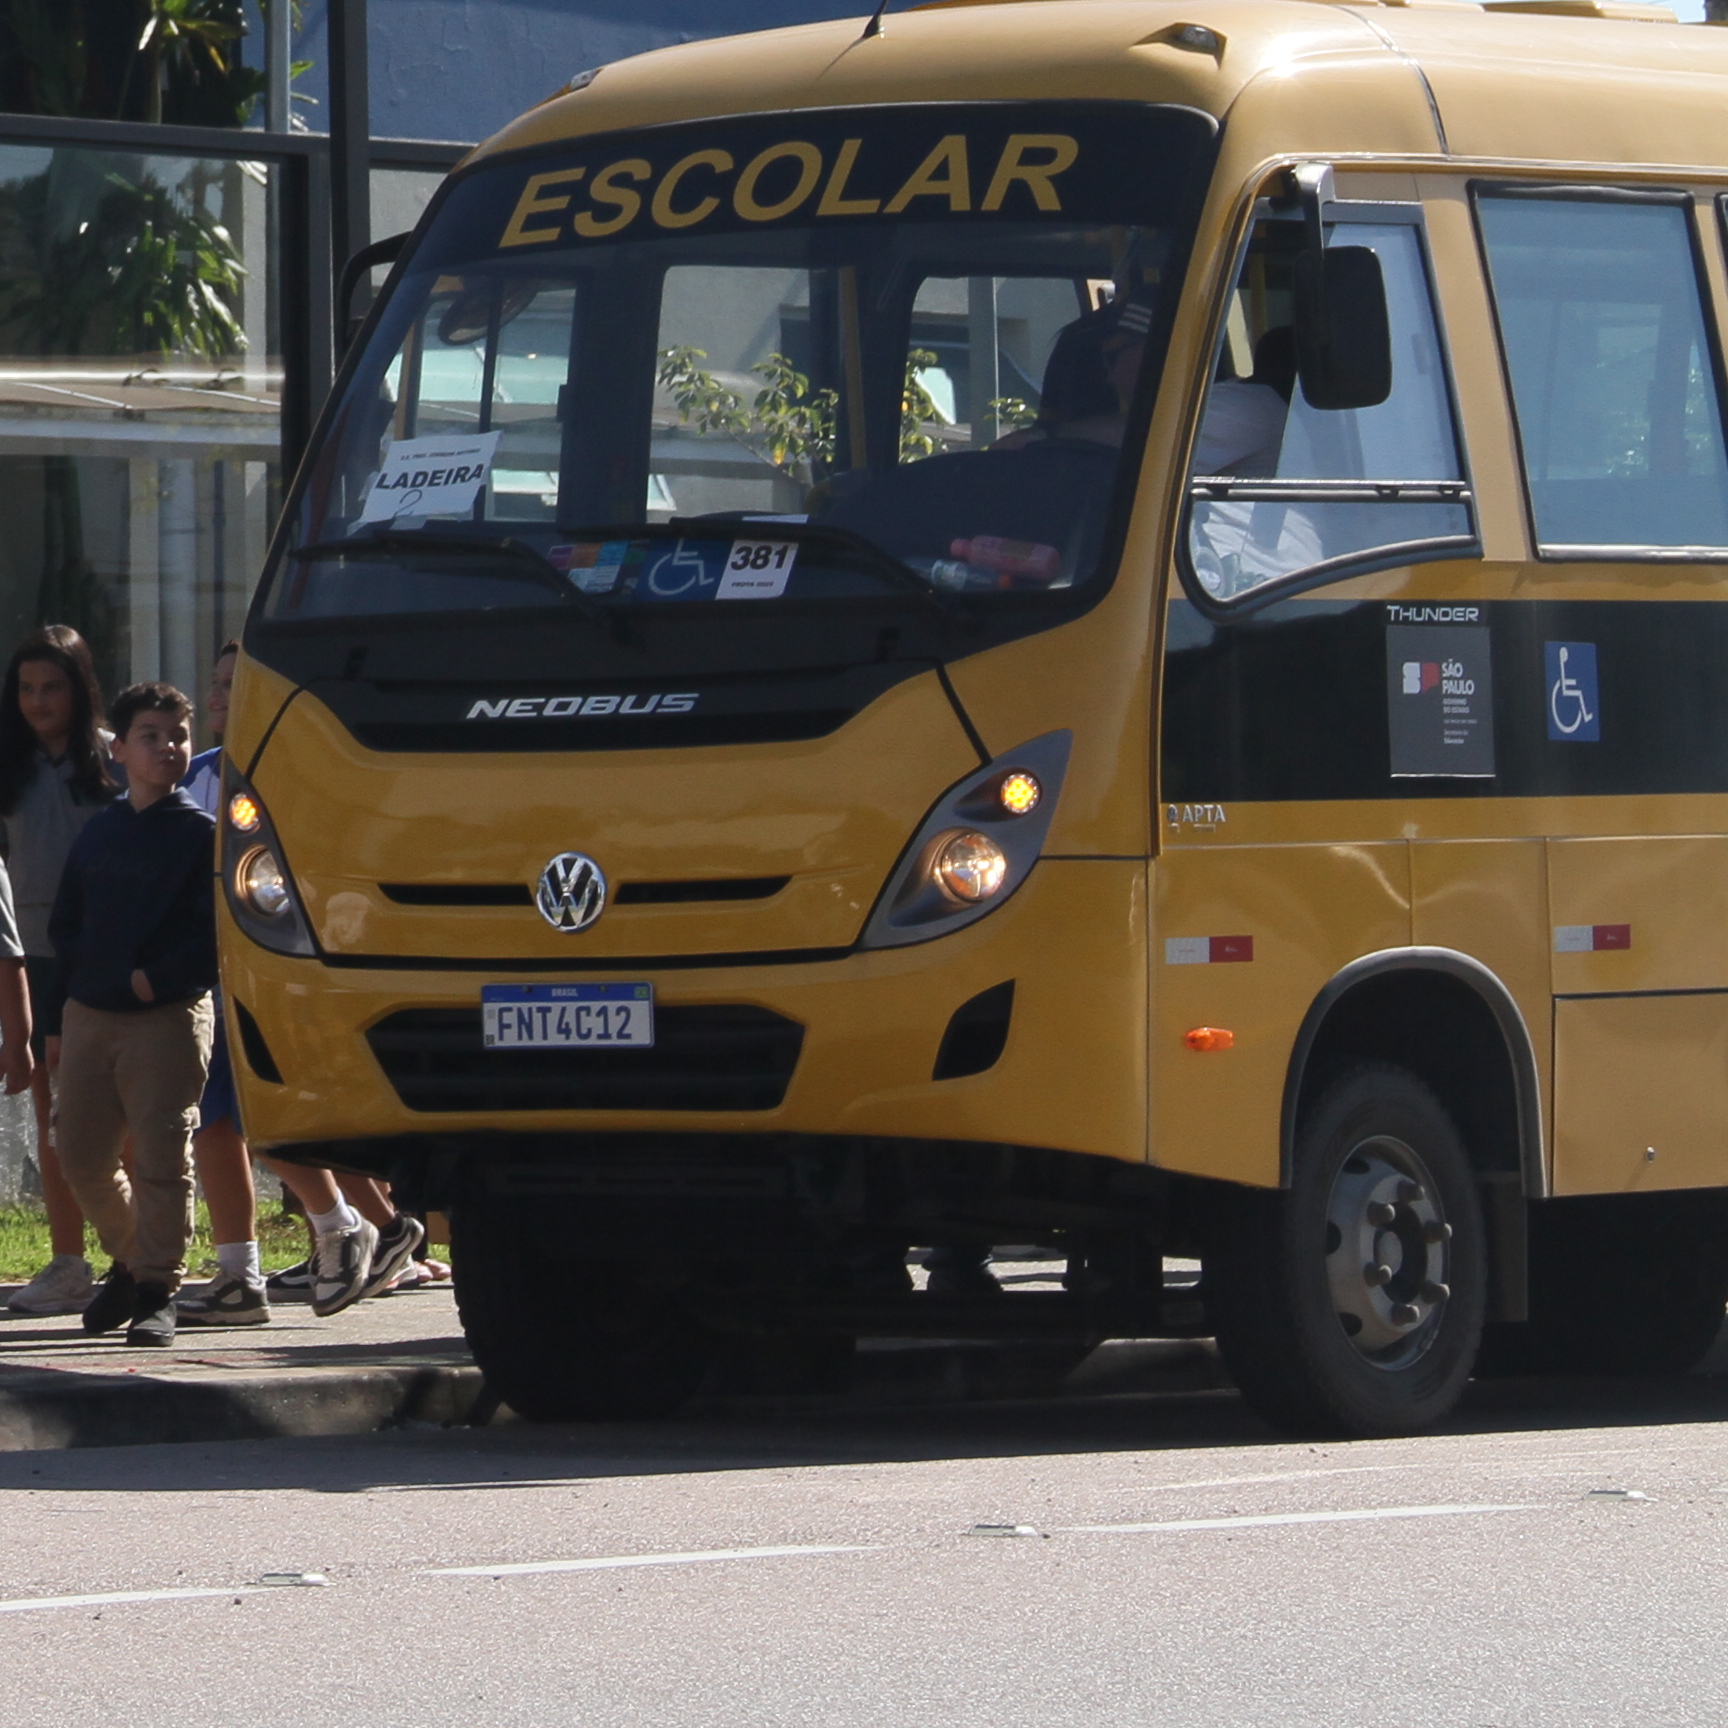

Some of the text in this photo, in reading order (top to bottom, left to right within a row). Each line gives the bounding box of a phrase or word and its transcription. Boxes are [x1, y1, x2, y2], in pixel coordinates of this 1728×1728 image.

[498, 133, 1079, 249] ESCOLAR
[375, 463, 484, 490] LADEIRA
[730, 544, 790, 571] 381
[1386, 605, 1479, 622] THUNDER
[1442, 658, 1463, 678] SÃO
[1442, 679, 1475, 695] PAULO
[467, 693, 700, 720] NEOBUS
[1182, 804, 1226, 822] APTA
[551, 988, 579, 998] BRASIL
[497, 1005, 632, 1042] FNT4C12
